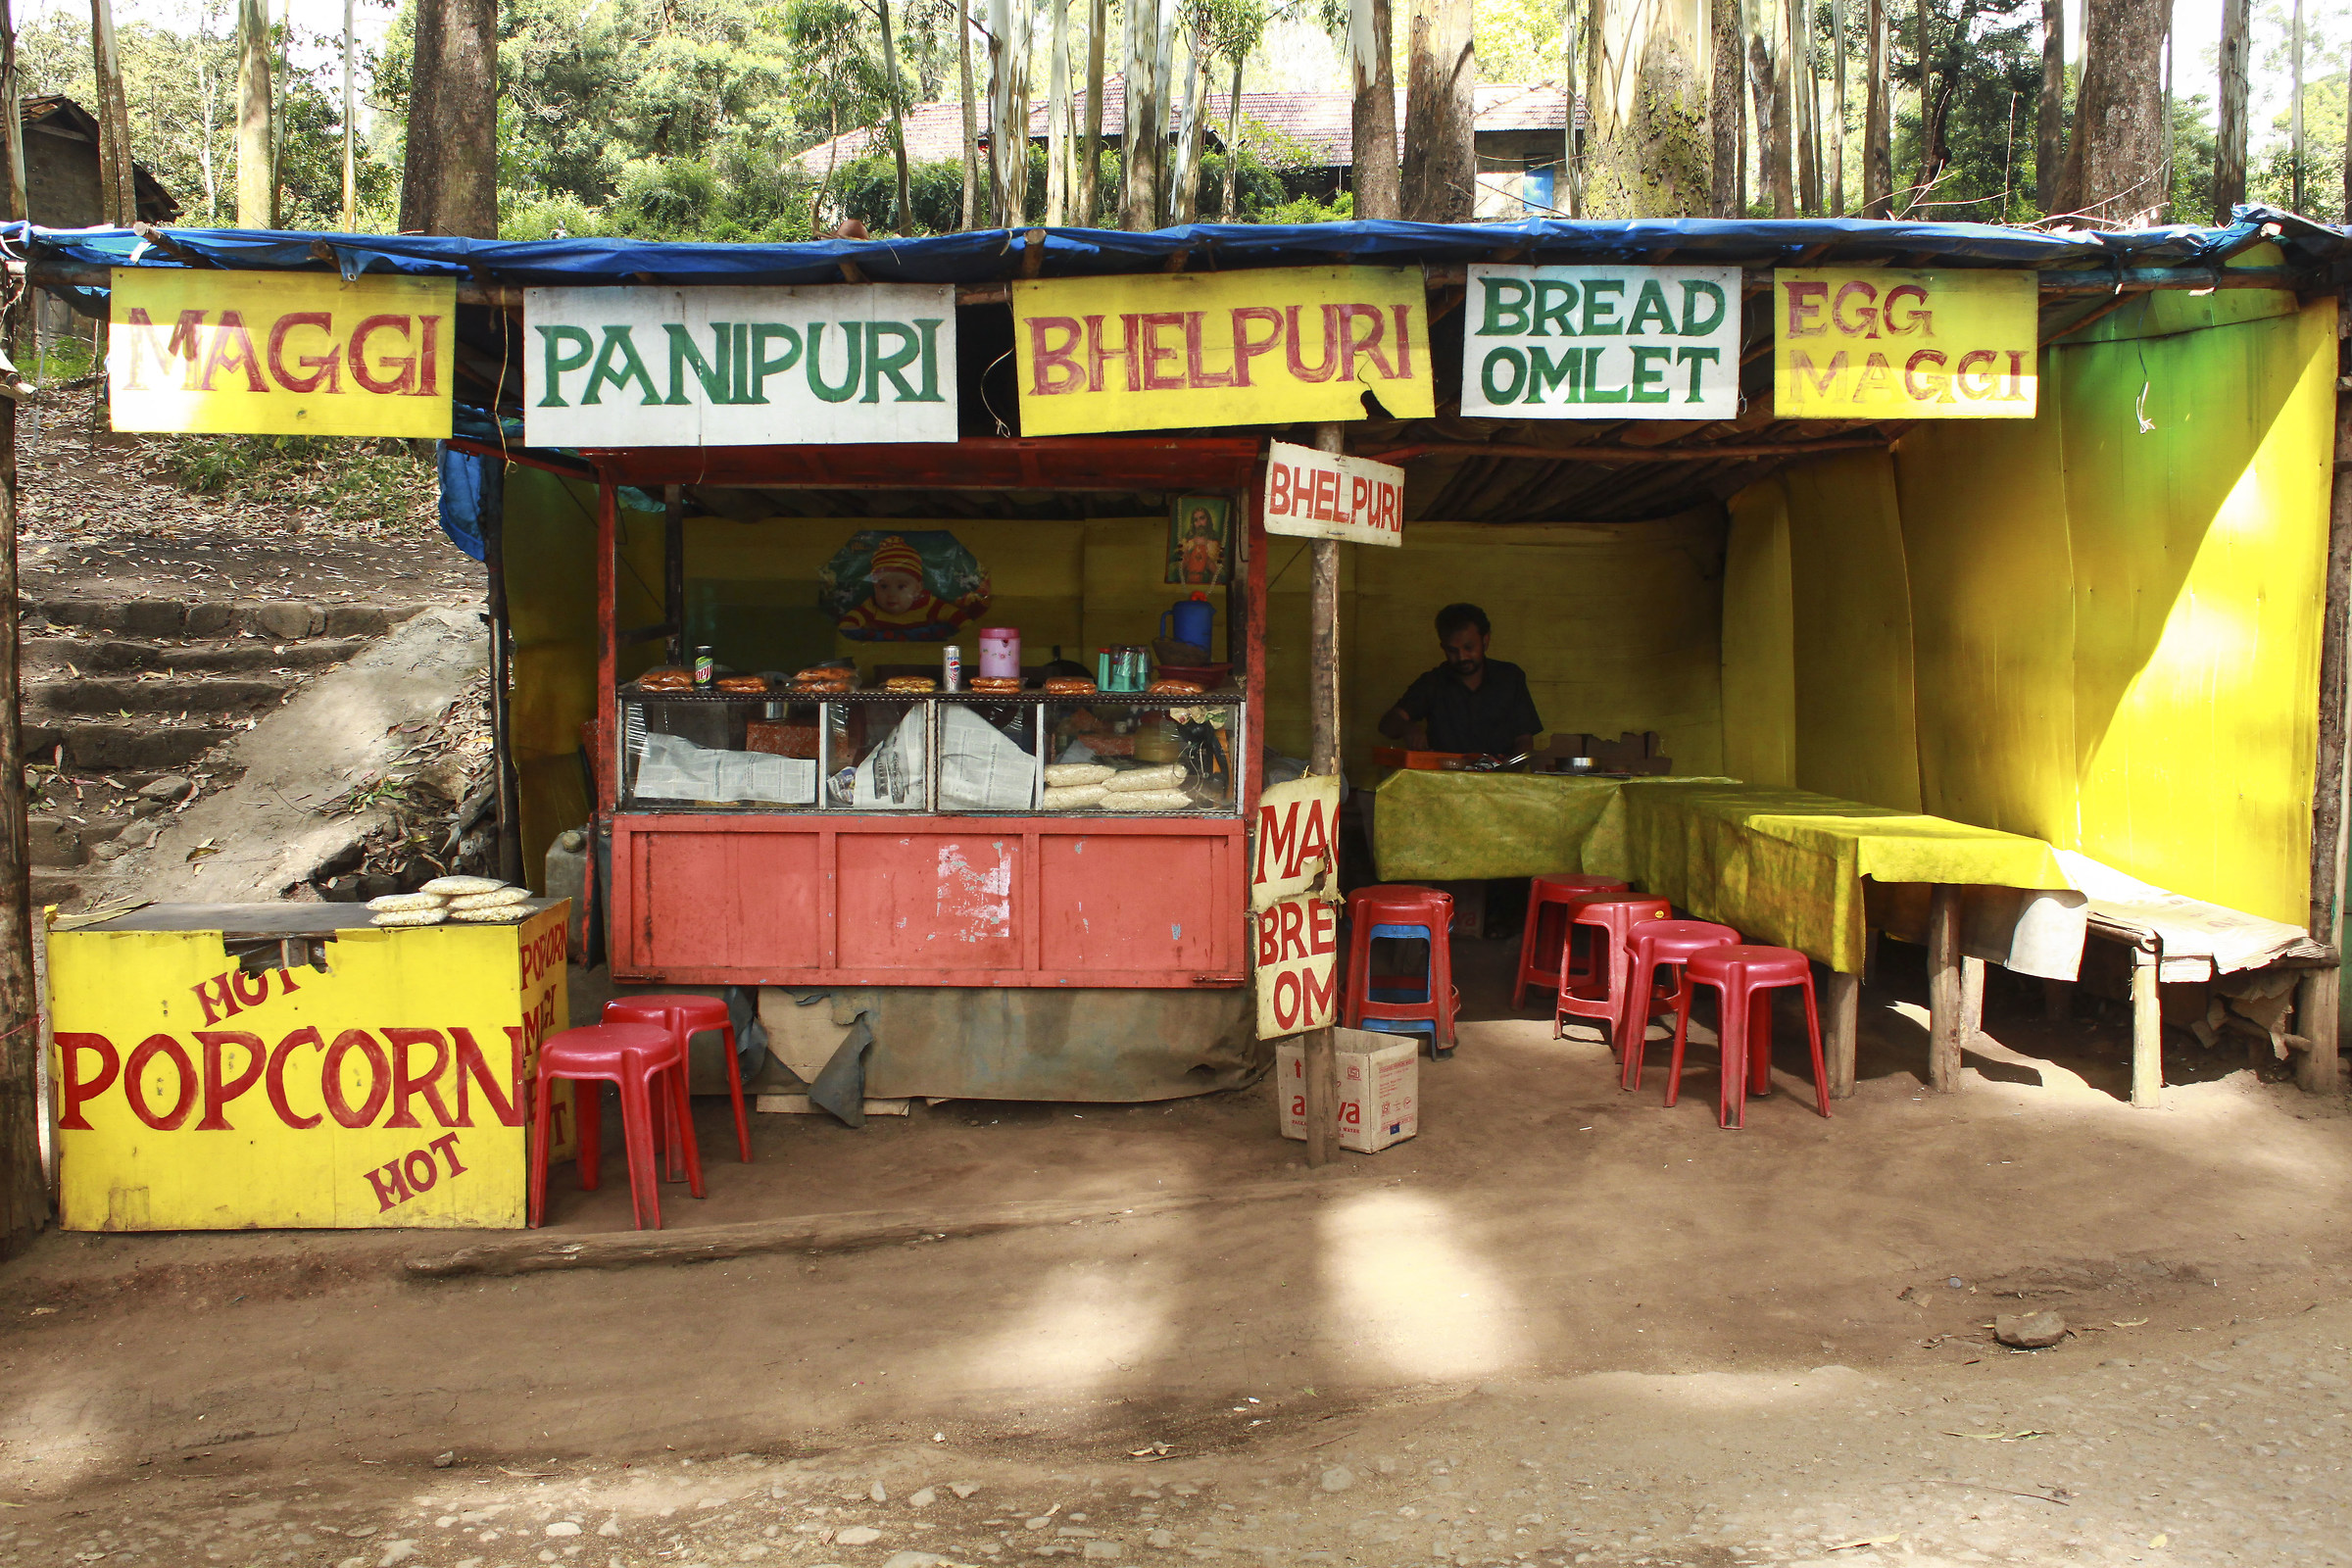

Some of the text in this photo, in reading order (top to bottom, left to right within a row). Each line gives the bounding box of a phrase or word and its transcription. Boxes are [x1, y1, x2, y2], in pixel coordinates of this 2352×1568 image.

[1474, 276, 1727, 337] BREAD
[1783, 280, 1937, 339] EGG
[124, 307, 443, 396] MAGGI
[533, 318, 947, 408] PANIPURI
[1023, 303, 1416, 397] BHELPURI
[1481, 346, 1721, 405] OMLET
[1785, 349, 2032, 405] MAGGI
[1269, 461, 1402, 533] BHELPURI
[1257, 898, 1336, 967] BRE
[54, 1026, 526, 1131] POPCORN
[363, 1131, 469, 1214] HOT
